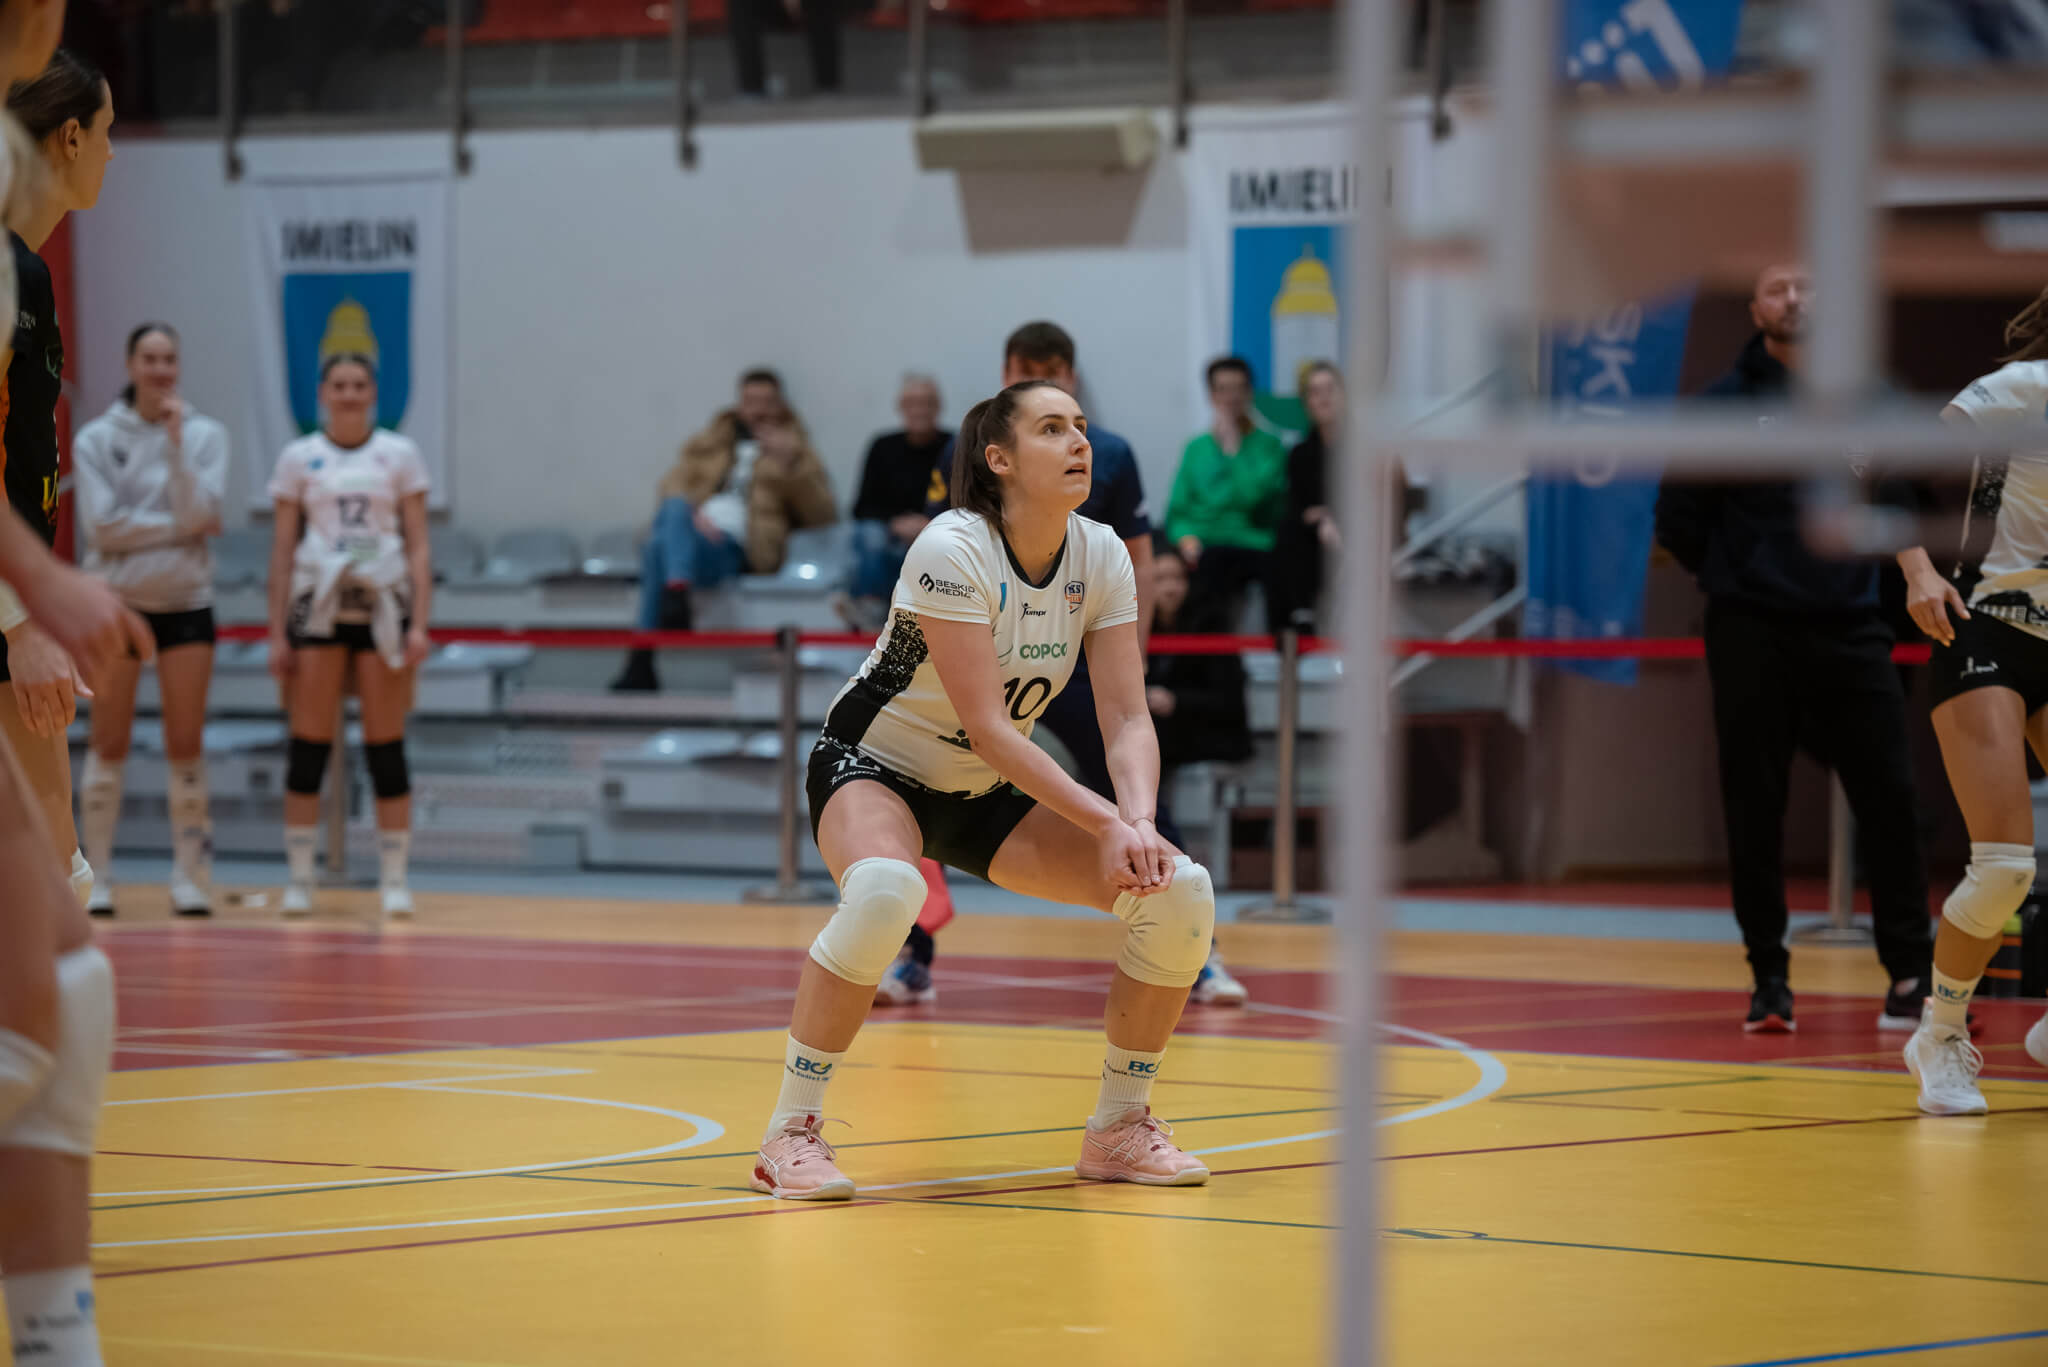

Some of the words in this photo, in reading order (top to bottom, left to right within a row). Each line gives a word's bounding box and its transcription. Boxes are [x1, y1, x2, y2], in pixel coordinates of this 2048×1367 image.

[1230, 167, 1393, 212] IMIELI
[281, 219, 416, 262] IMIELIN
[935, 579, 976, 593] BESKID
[1004, 676, 1052, 721] 10
